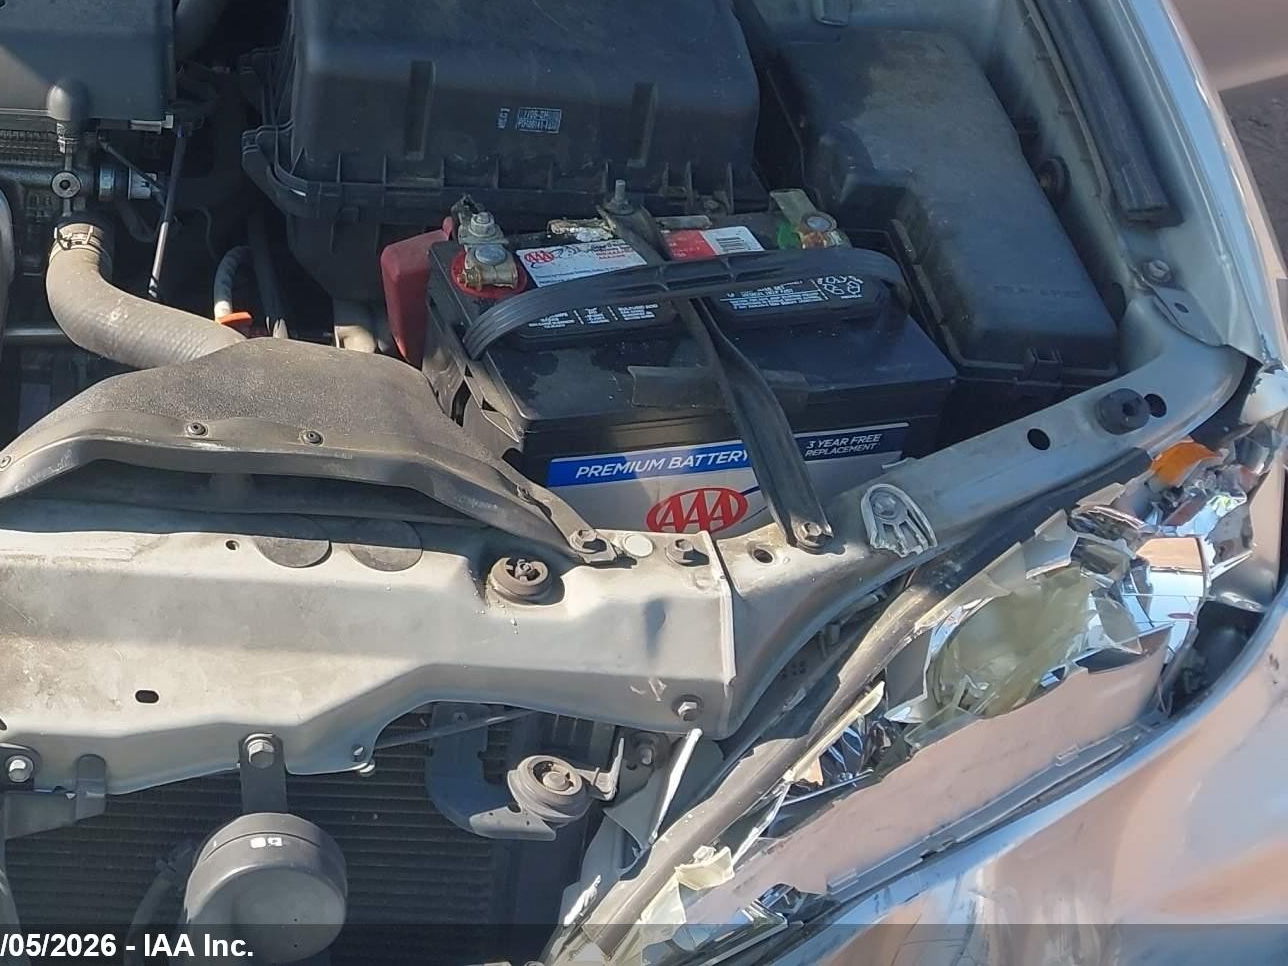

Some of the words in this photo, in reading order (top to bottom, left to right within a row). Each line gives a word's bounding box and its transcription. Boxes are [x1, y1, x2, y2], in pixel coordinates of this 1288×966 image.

[805, 442, 878, 458] REPLACEMENT
[806, 440, 817, 450] 3
[818, 437, 850, 448] YEAR
[850, 434, 883, 445] FREE
[575, 457, 665, 479] PREMIUM
[649, 488, 746, 534] AAA
